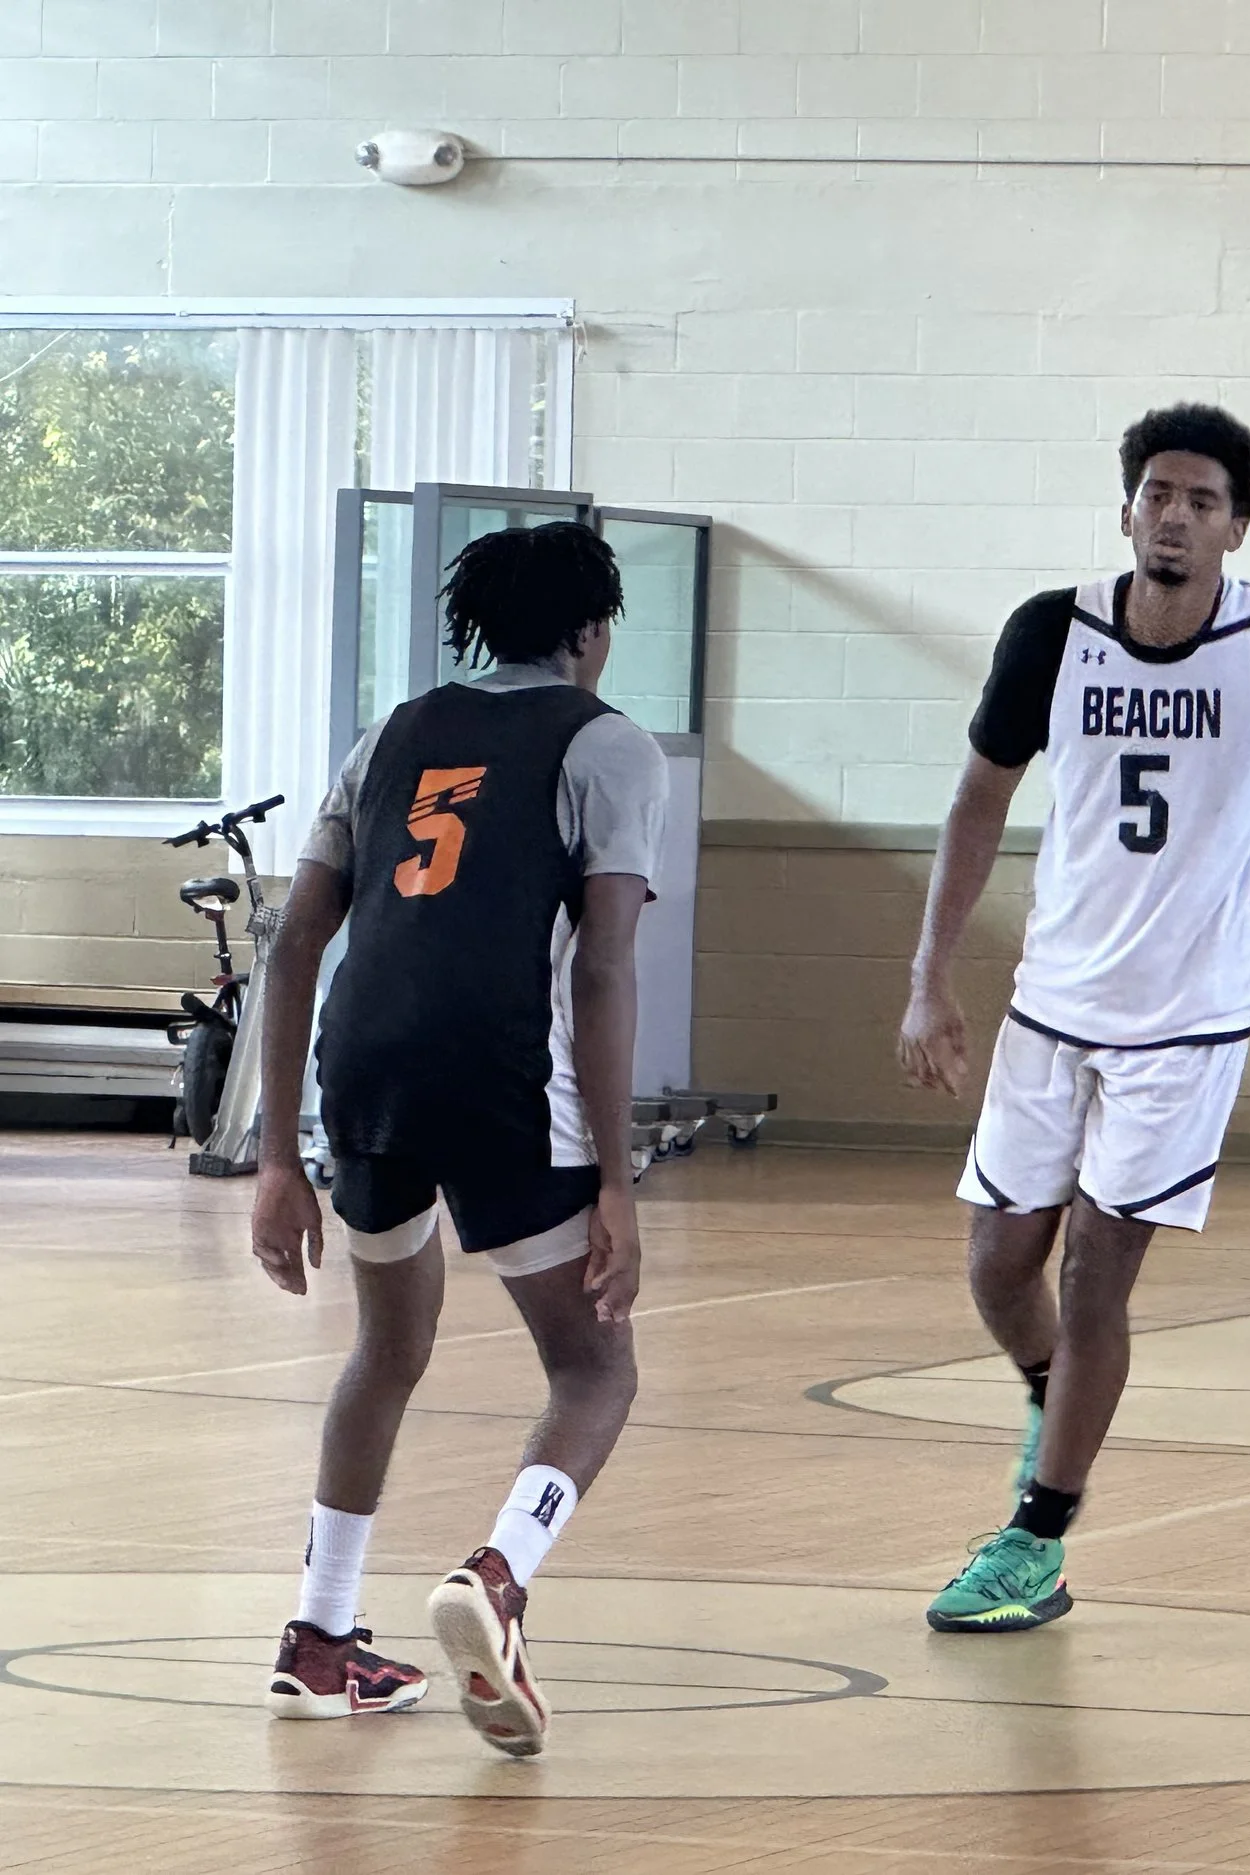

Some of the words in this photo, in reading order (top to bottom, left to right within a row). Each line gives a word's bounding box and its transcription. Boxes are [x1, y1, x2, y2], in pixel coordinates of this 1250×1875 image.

[1082, 686, 1221, 739] BEACON
[393, 766, 488, 898] 5
[1119, 754, 1170, 855] 5
